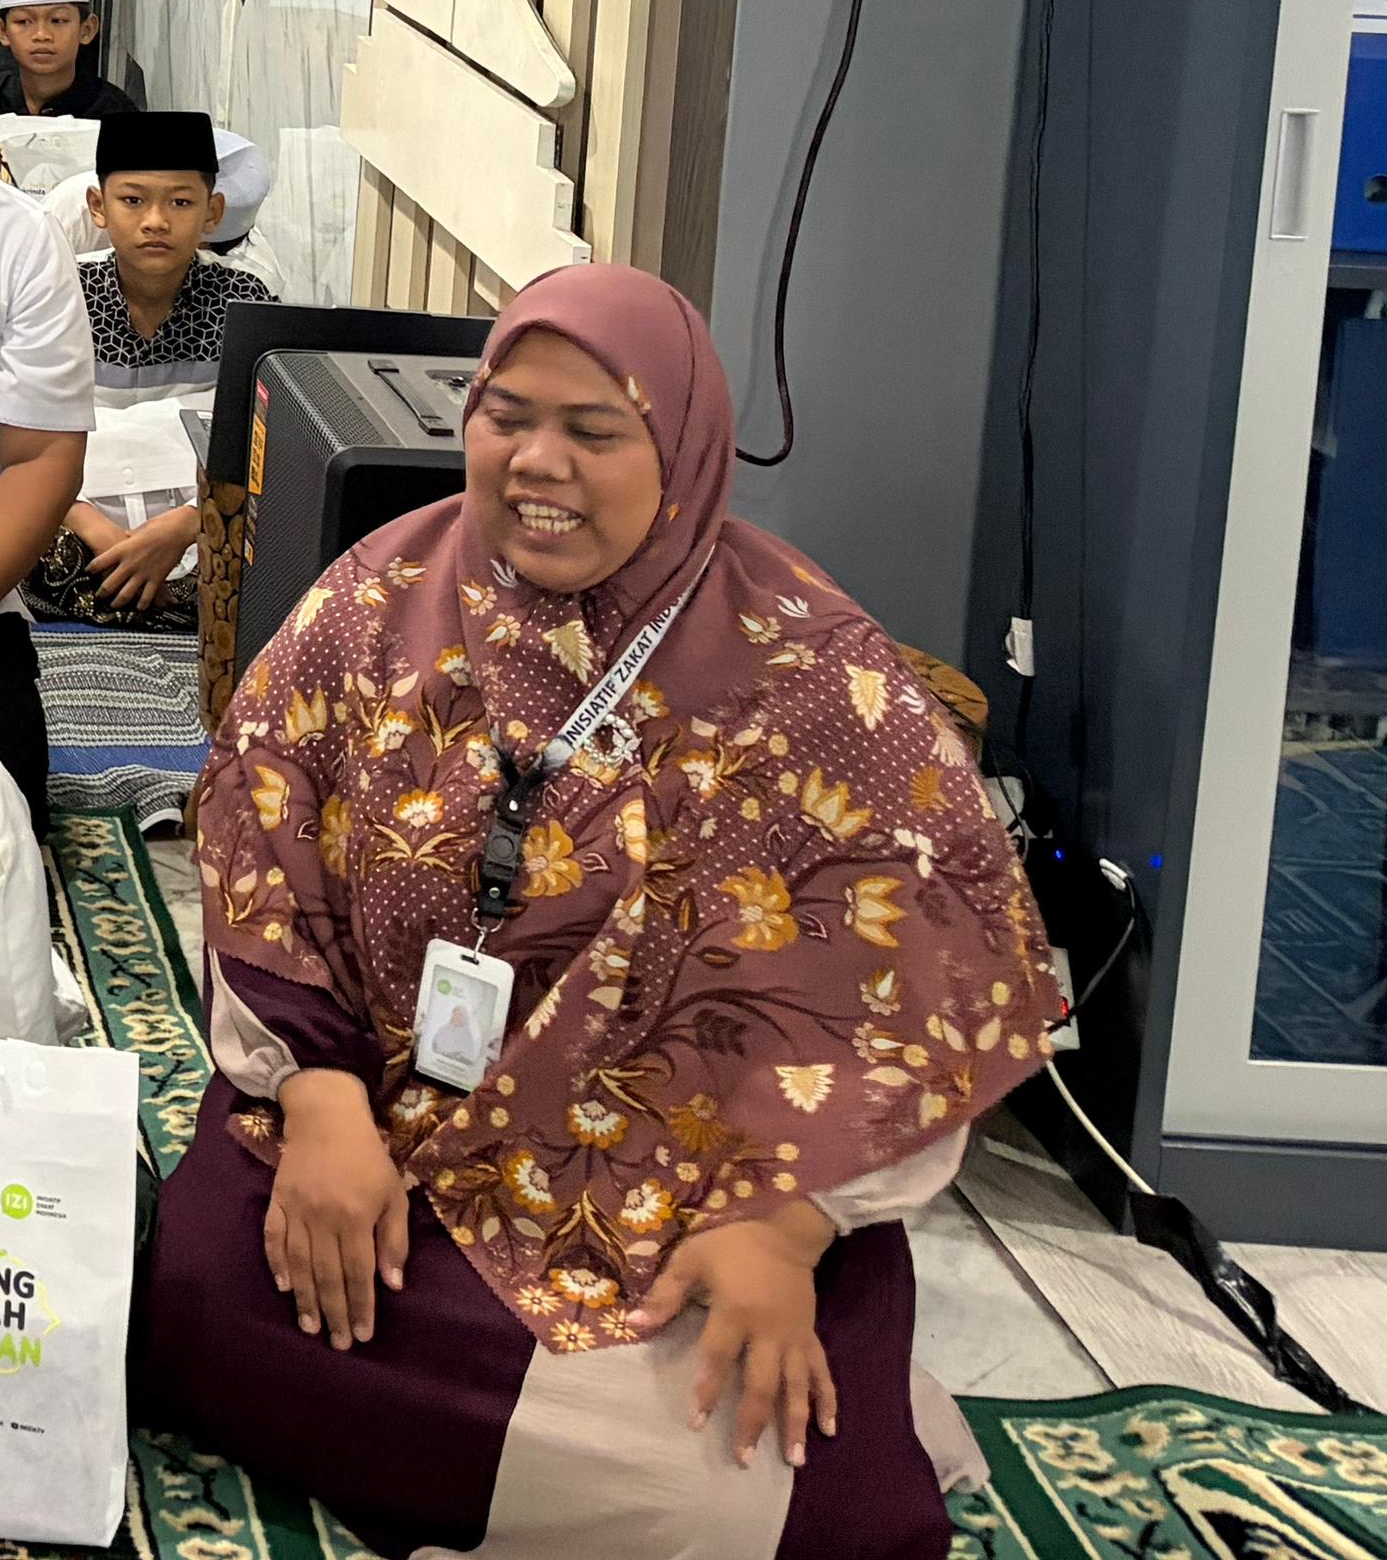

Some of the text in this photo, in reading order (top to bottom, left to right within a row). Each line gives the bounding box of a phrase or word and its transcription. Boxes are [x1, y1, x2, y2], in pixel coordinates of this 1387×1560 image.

[563, 679, 617, 748] INISIATIF
[614, 630, 654, 683] ZAKAT
[5, 1192, 28, 1211] IZI
